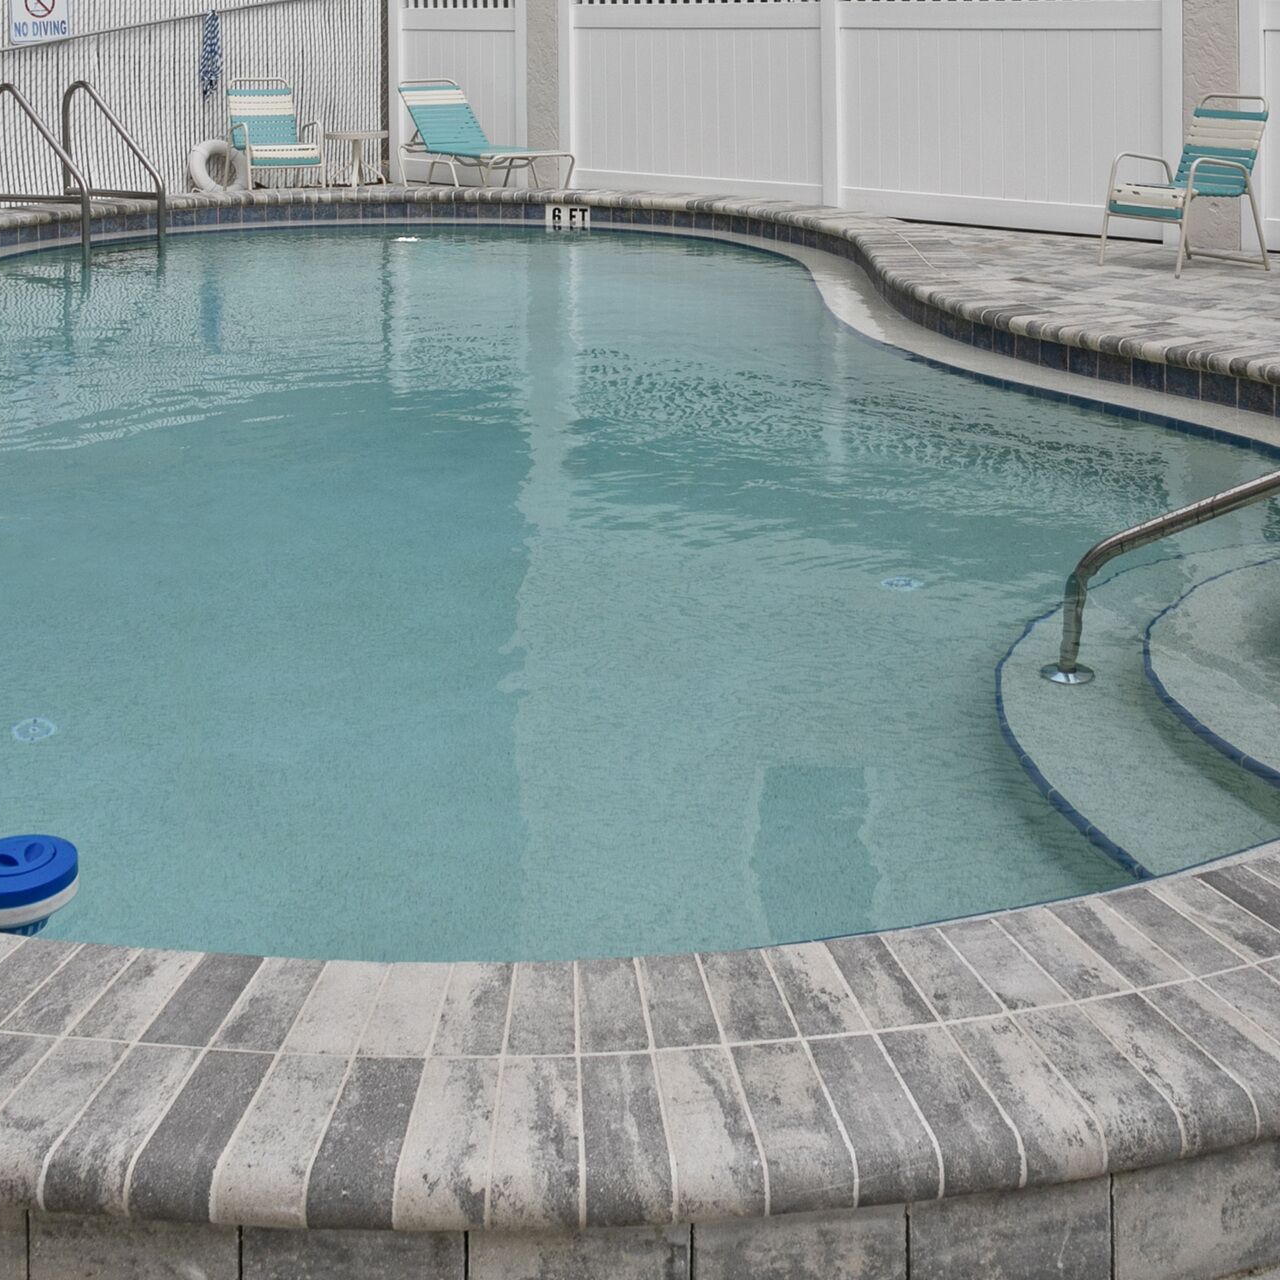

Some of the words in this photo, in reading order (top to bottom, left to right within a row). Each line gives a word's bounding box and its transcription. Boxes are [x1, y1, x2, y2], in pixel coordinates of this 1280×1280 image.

[14, 21, 28, 37] NO
[32, 20, 67, 37] DIVING
[552, 207, 562, 221] 6
[569, 207, 588, 221] FT
